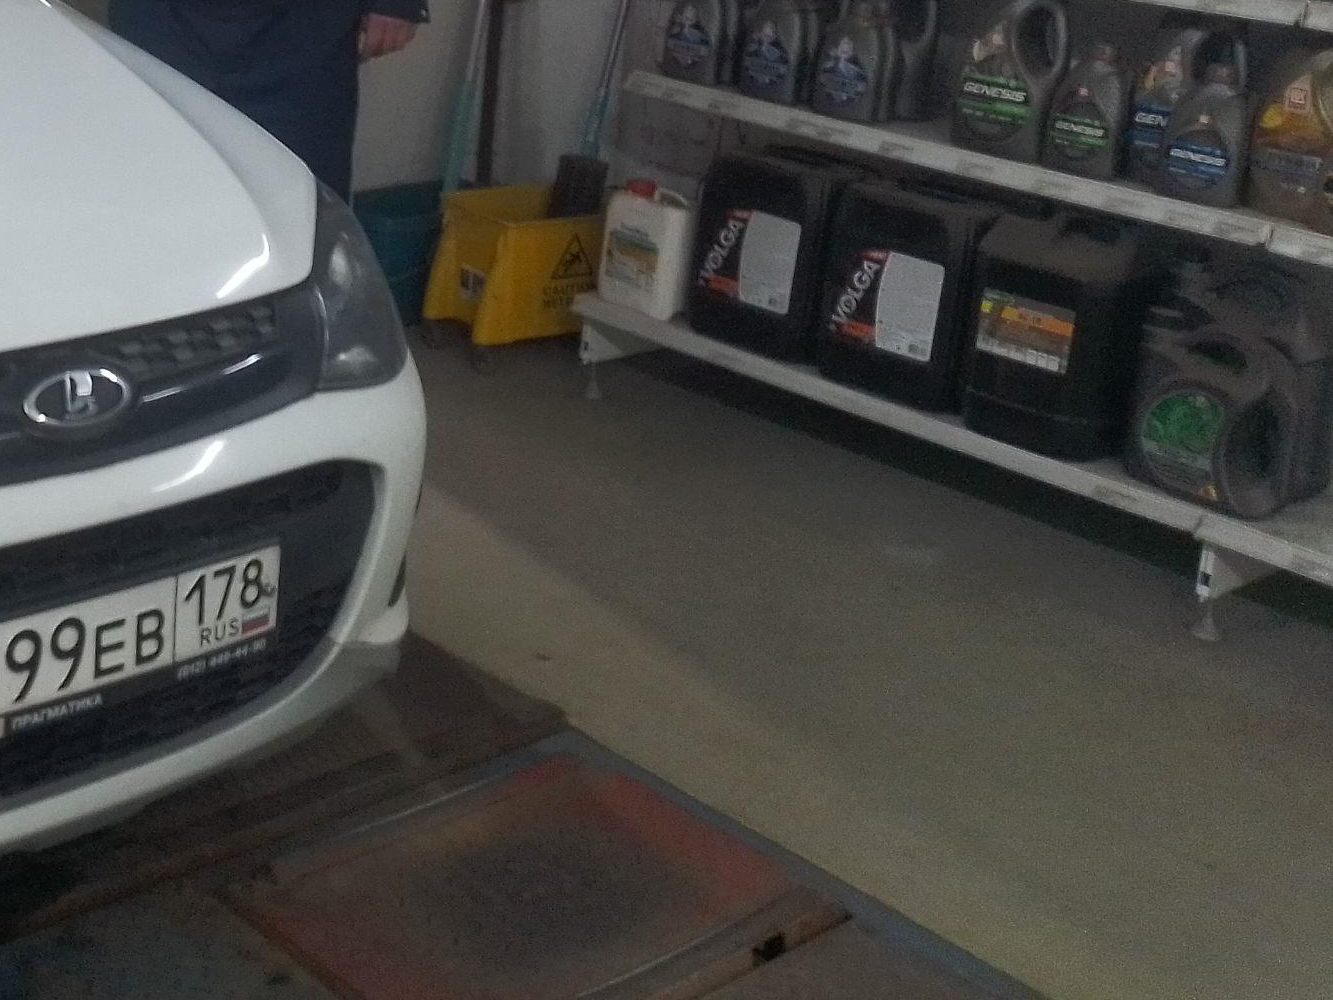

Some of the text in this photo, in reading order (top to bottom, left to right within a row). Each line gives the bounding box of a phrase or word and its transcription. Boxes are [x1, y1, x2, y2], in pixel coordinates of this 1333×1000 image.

[963, 82, 1027, 102] GENESIS
[184, 558, 264, 627] 178
[199, 620, 242, 648] RUS
[11, 694, 103, 730] ПРАГМАТИКА
